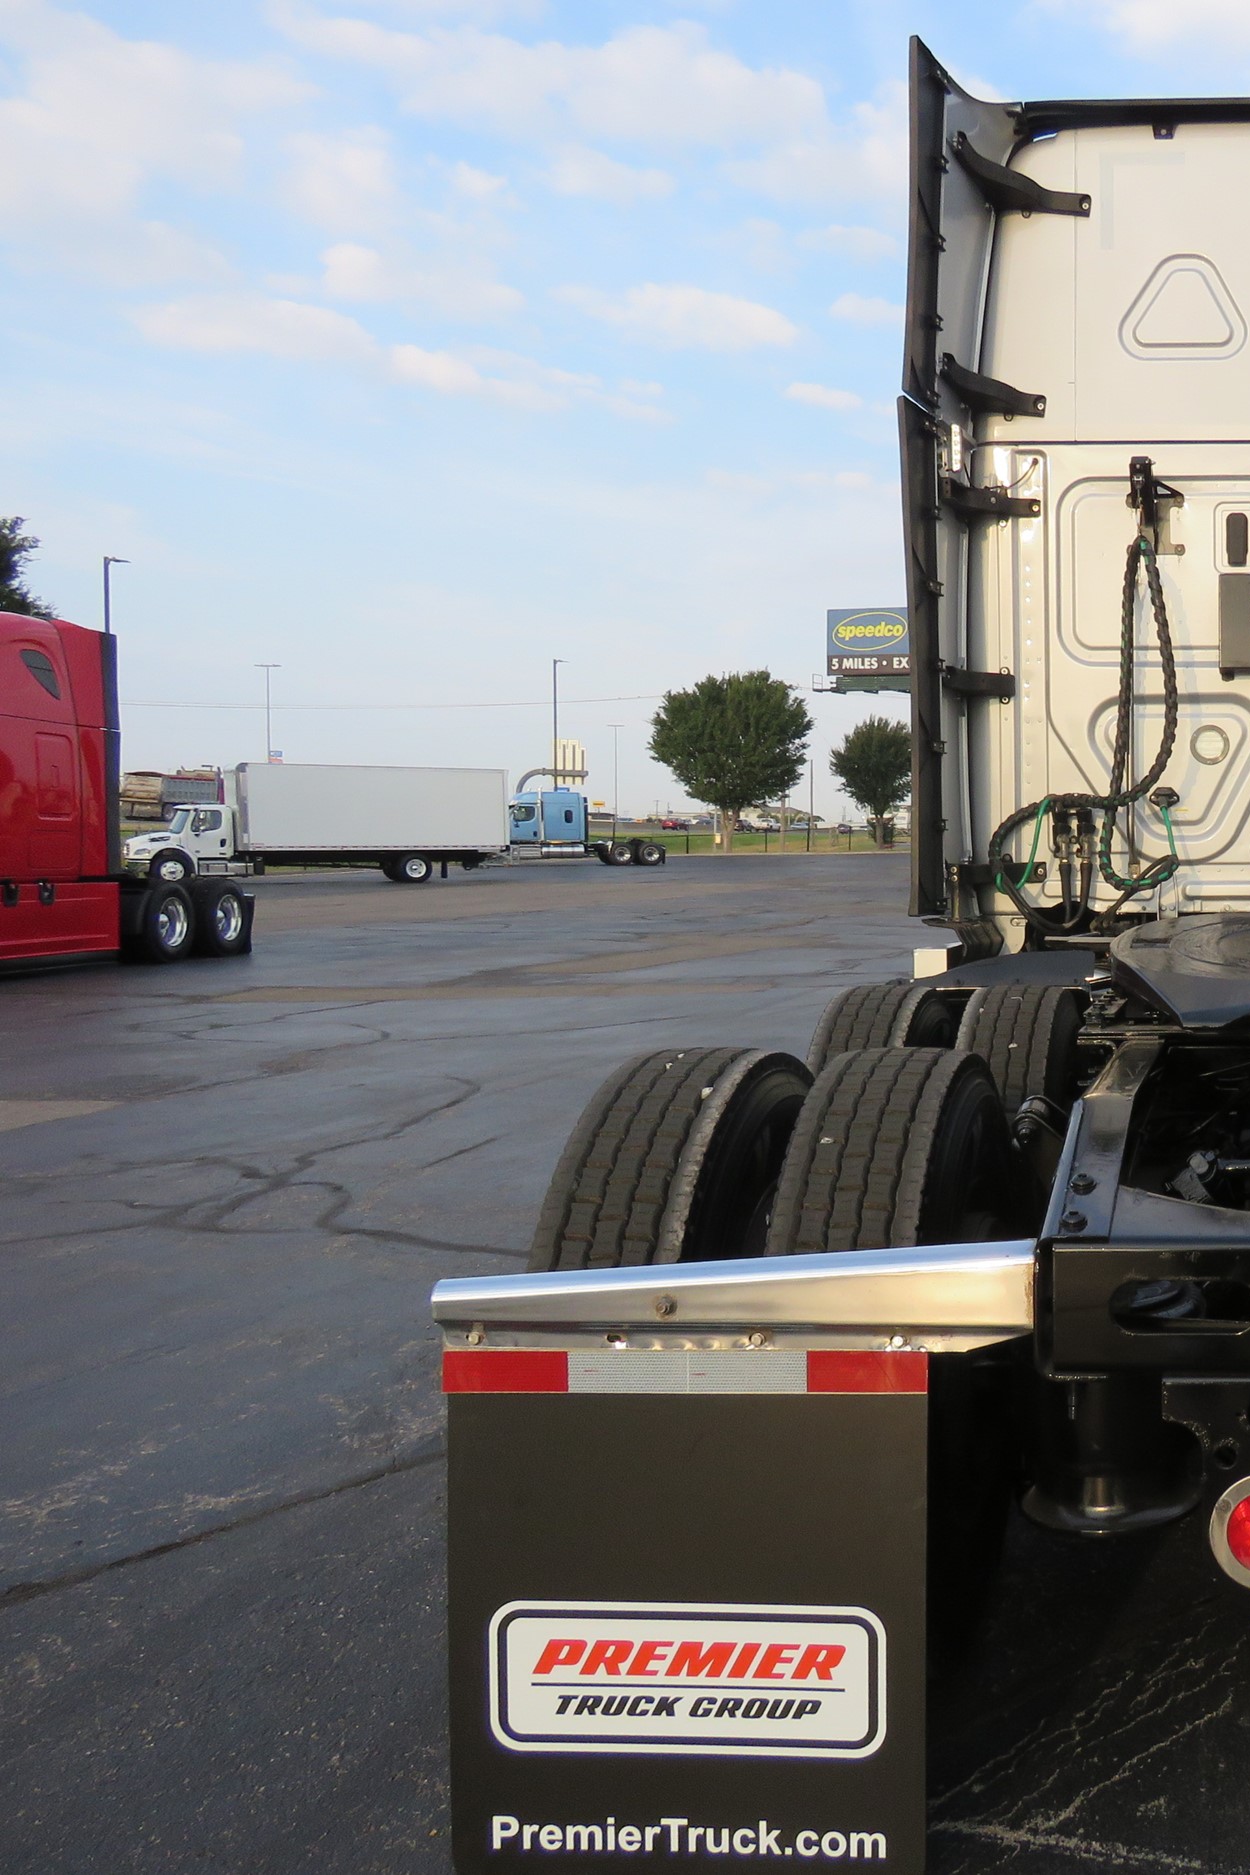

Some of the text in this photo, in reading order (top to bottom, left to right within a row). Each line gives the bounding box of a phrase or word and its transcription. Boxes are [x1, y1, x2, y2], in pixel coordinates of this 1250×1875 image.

[837, 621, 903, 641] speedco
[831, 658, 839, 670] 5
[842, 657, 878, 669] MILES
[531, 1639, 846, 1680] PREMIER
[555, 1694, 822, 1719] TRUCK GROUP
[491, 1815, 887, 1858] PremierTruck.com
